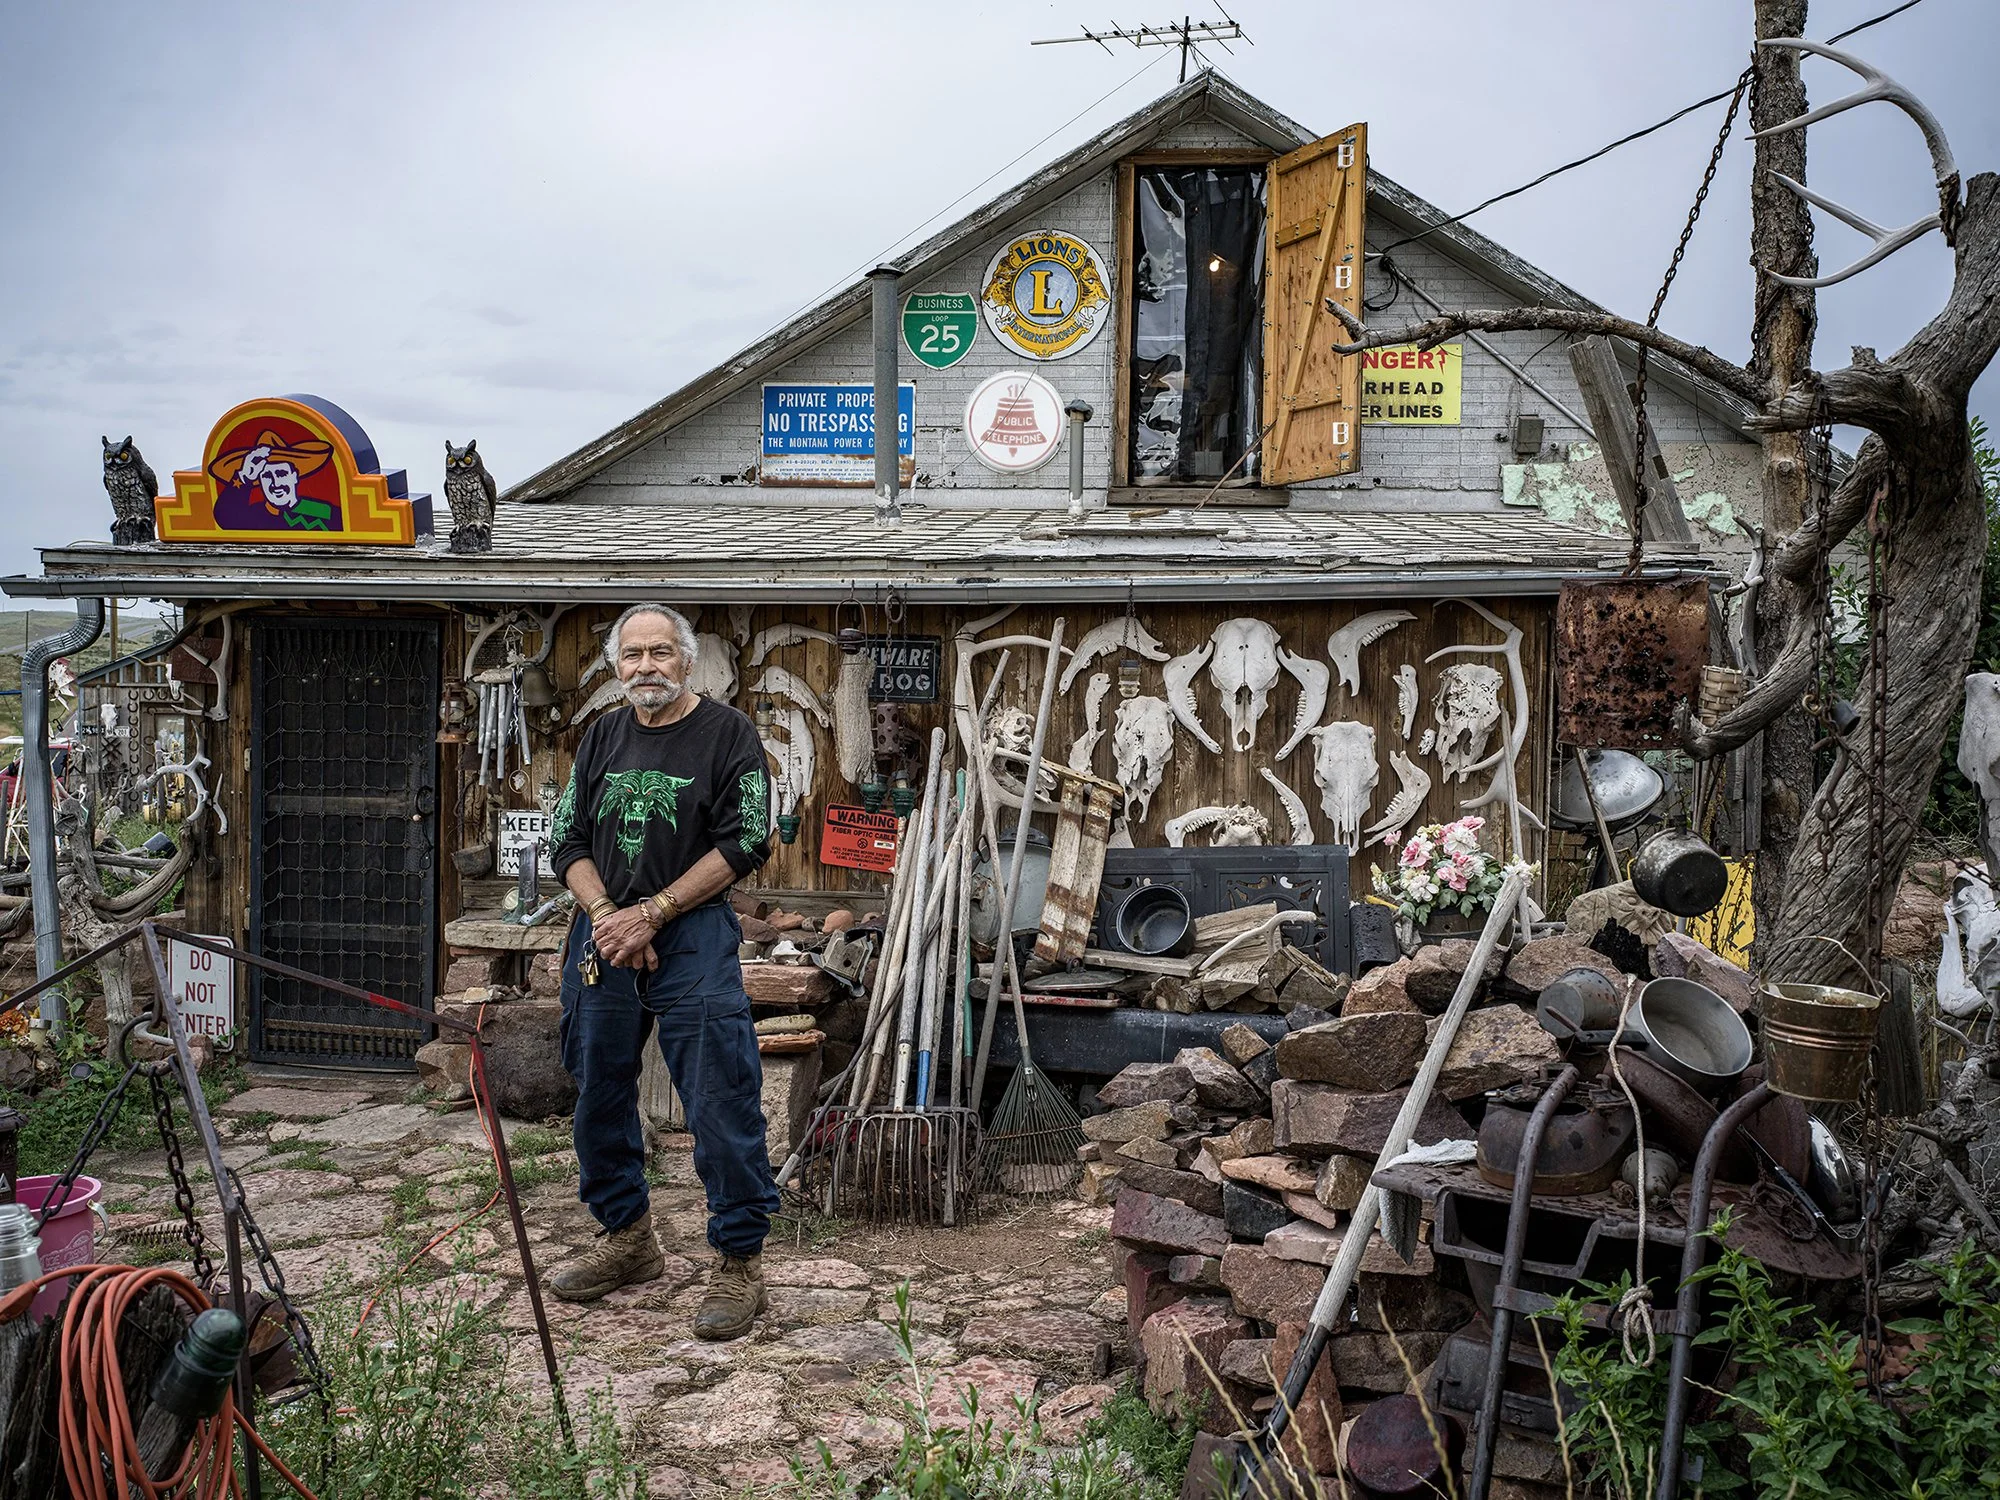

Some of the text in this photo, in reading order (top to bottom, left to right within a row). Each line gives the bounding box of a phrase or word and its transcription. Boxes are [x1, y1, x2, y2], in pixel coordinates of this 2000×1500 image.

[1015, 239, 1082, 263] LIONS
[1029, 270, 1064, 317] L
[917, 299, 964, 309] BUSINESS
[920, 325, 960, 352] 25
[1008, 319, 1083, 344] INTERNATIONAL
[1362, 351, 1434, 369] NGER
[1365, 382, 1444, 395] RHEAD
[778, 393, 876, 408] PRIVATE PROPE
[1388, 405, 1443, 418] LINES
[768, 413, 908, 433] NO TRESPASSG
[997, 416, 1033, 426] PUBLIC
[768, 437, 784, 448] THE
[789, 438, 829, 448] MONTANA
[834, 438, 862, 449] POWER
[987, 431, 1043, 444] TELEPHONE
[837, 810, 895, 829] WARNING
[832, 826, 896, 841] FIBER OPTIC CABLE
[190, 949, 212, 971] DO
[185, 981, 216, 1004] NOT
[178, 1012, 226, 1036] NTER
